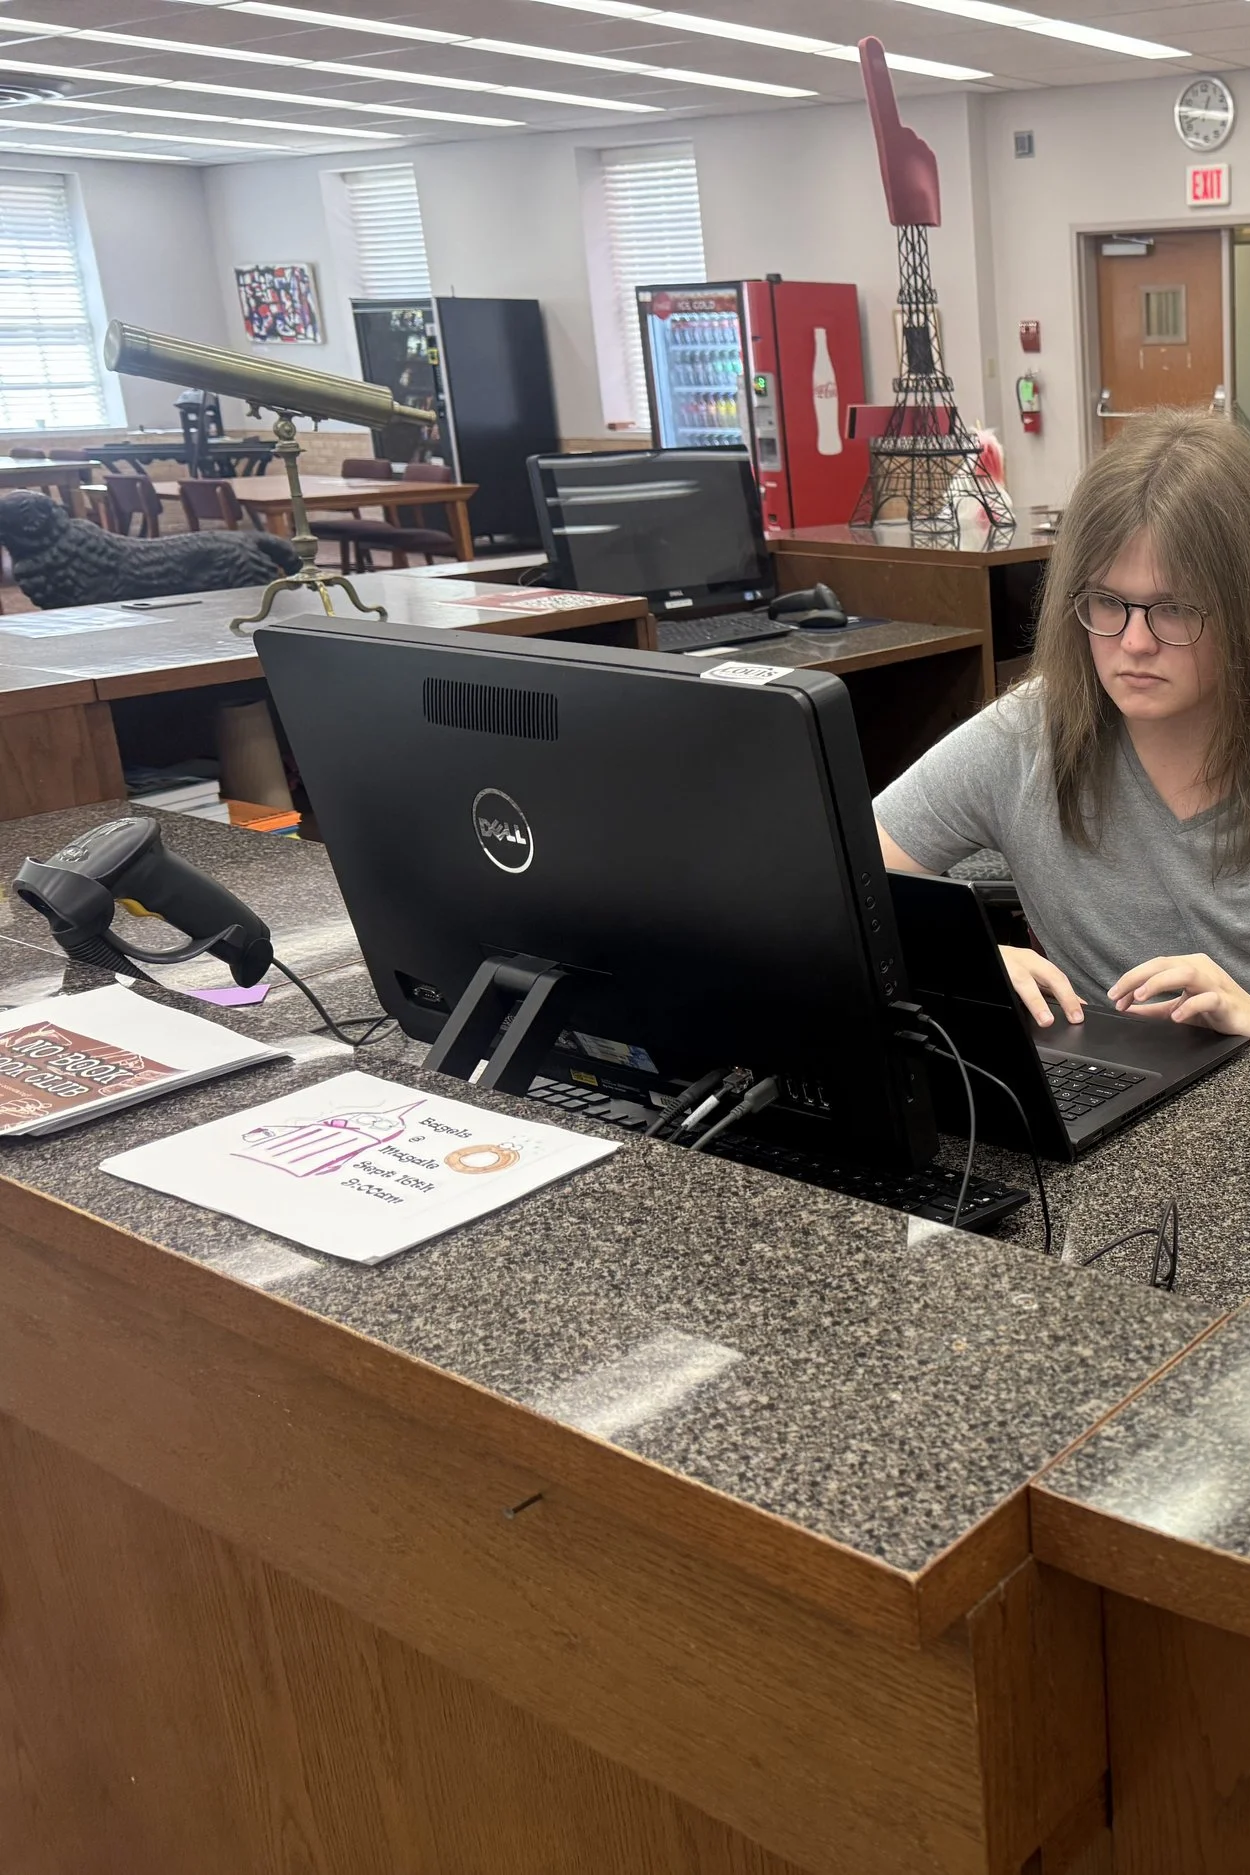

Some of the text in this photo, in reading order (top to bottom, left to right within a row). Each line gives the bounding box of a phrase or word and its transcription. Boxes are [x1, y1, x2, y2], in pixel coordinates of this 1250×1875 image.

[1192, 169, 1222, 200] EXIT
[677, 301, 716, 310] ICE COLD
[721, 667, 779, 678] LOUIS
[478, 817, 527, 845] DELL
[12, 1040, 134, 1085] NO BOOK
[0, 1057, 38, 1078] OOK
[24, 1072, 89, 1097] CLUB
[408, 1135, 426, 1143] @
[418, 1117, 473, 1139] Bagels
[378, 1145, 440, 1169] Magale
[394, 1174, 435, 1193] 16th
